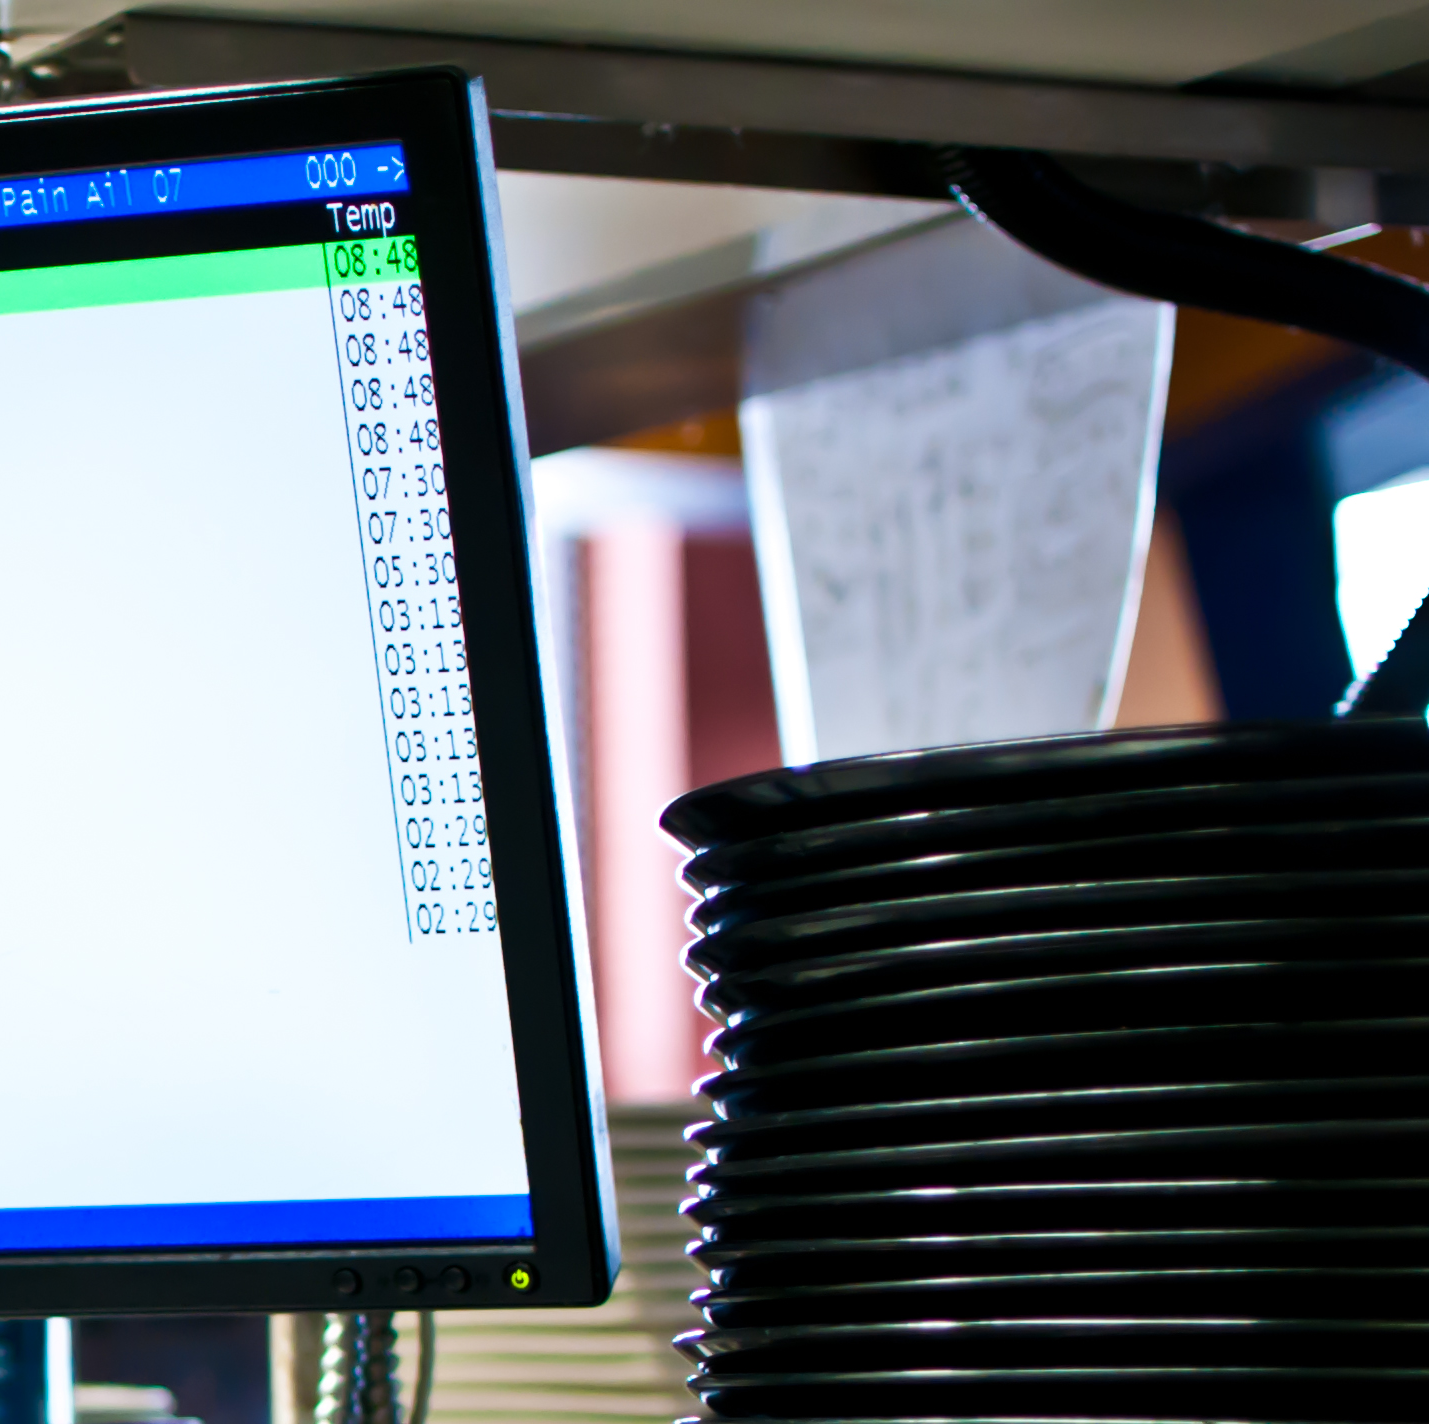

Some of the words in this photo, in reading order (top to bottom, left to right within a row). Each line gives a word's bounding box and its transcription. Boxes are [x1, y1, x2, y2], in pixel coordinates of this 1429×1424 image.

[2, 177, 69, 218] Pain
[86, 169, 133, 210] Ail
[152, 167, 182, 204] 07
[326, 201, 397, 239] Temp
[333, 238, 420, 279] 08:48
[340, 282, 425, 323] 08:48
[345, 328, 431, 368] 08:48
[351, 373, 436, 412] 08:48
[357, 418, 441, 456] 08:48
[362, 463, 447, 501] 07:30
[368, 507, 452, 545] 07:30
[373, 551, 457, 589] 05:30
[379, 596, 462, 633] 03:13
[385, 639, 467, 676] 03:13
[390, 683, 472, 720] 03:13
[395, 727, 478, 763] 03:13
[401, 771, 483, 806] 03:13
[406, 814, 487, 849] 02:29
[411, 857, 492, 892] 02:29
[416, 900, 498, 935] 02:29
